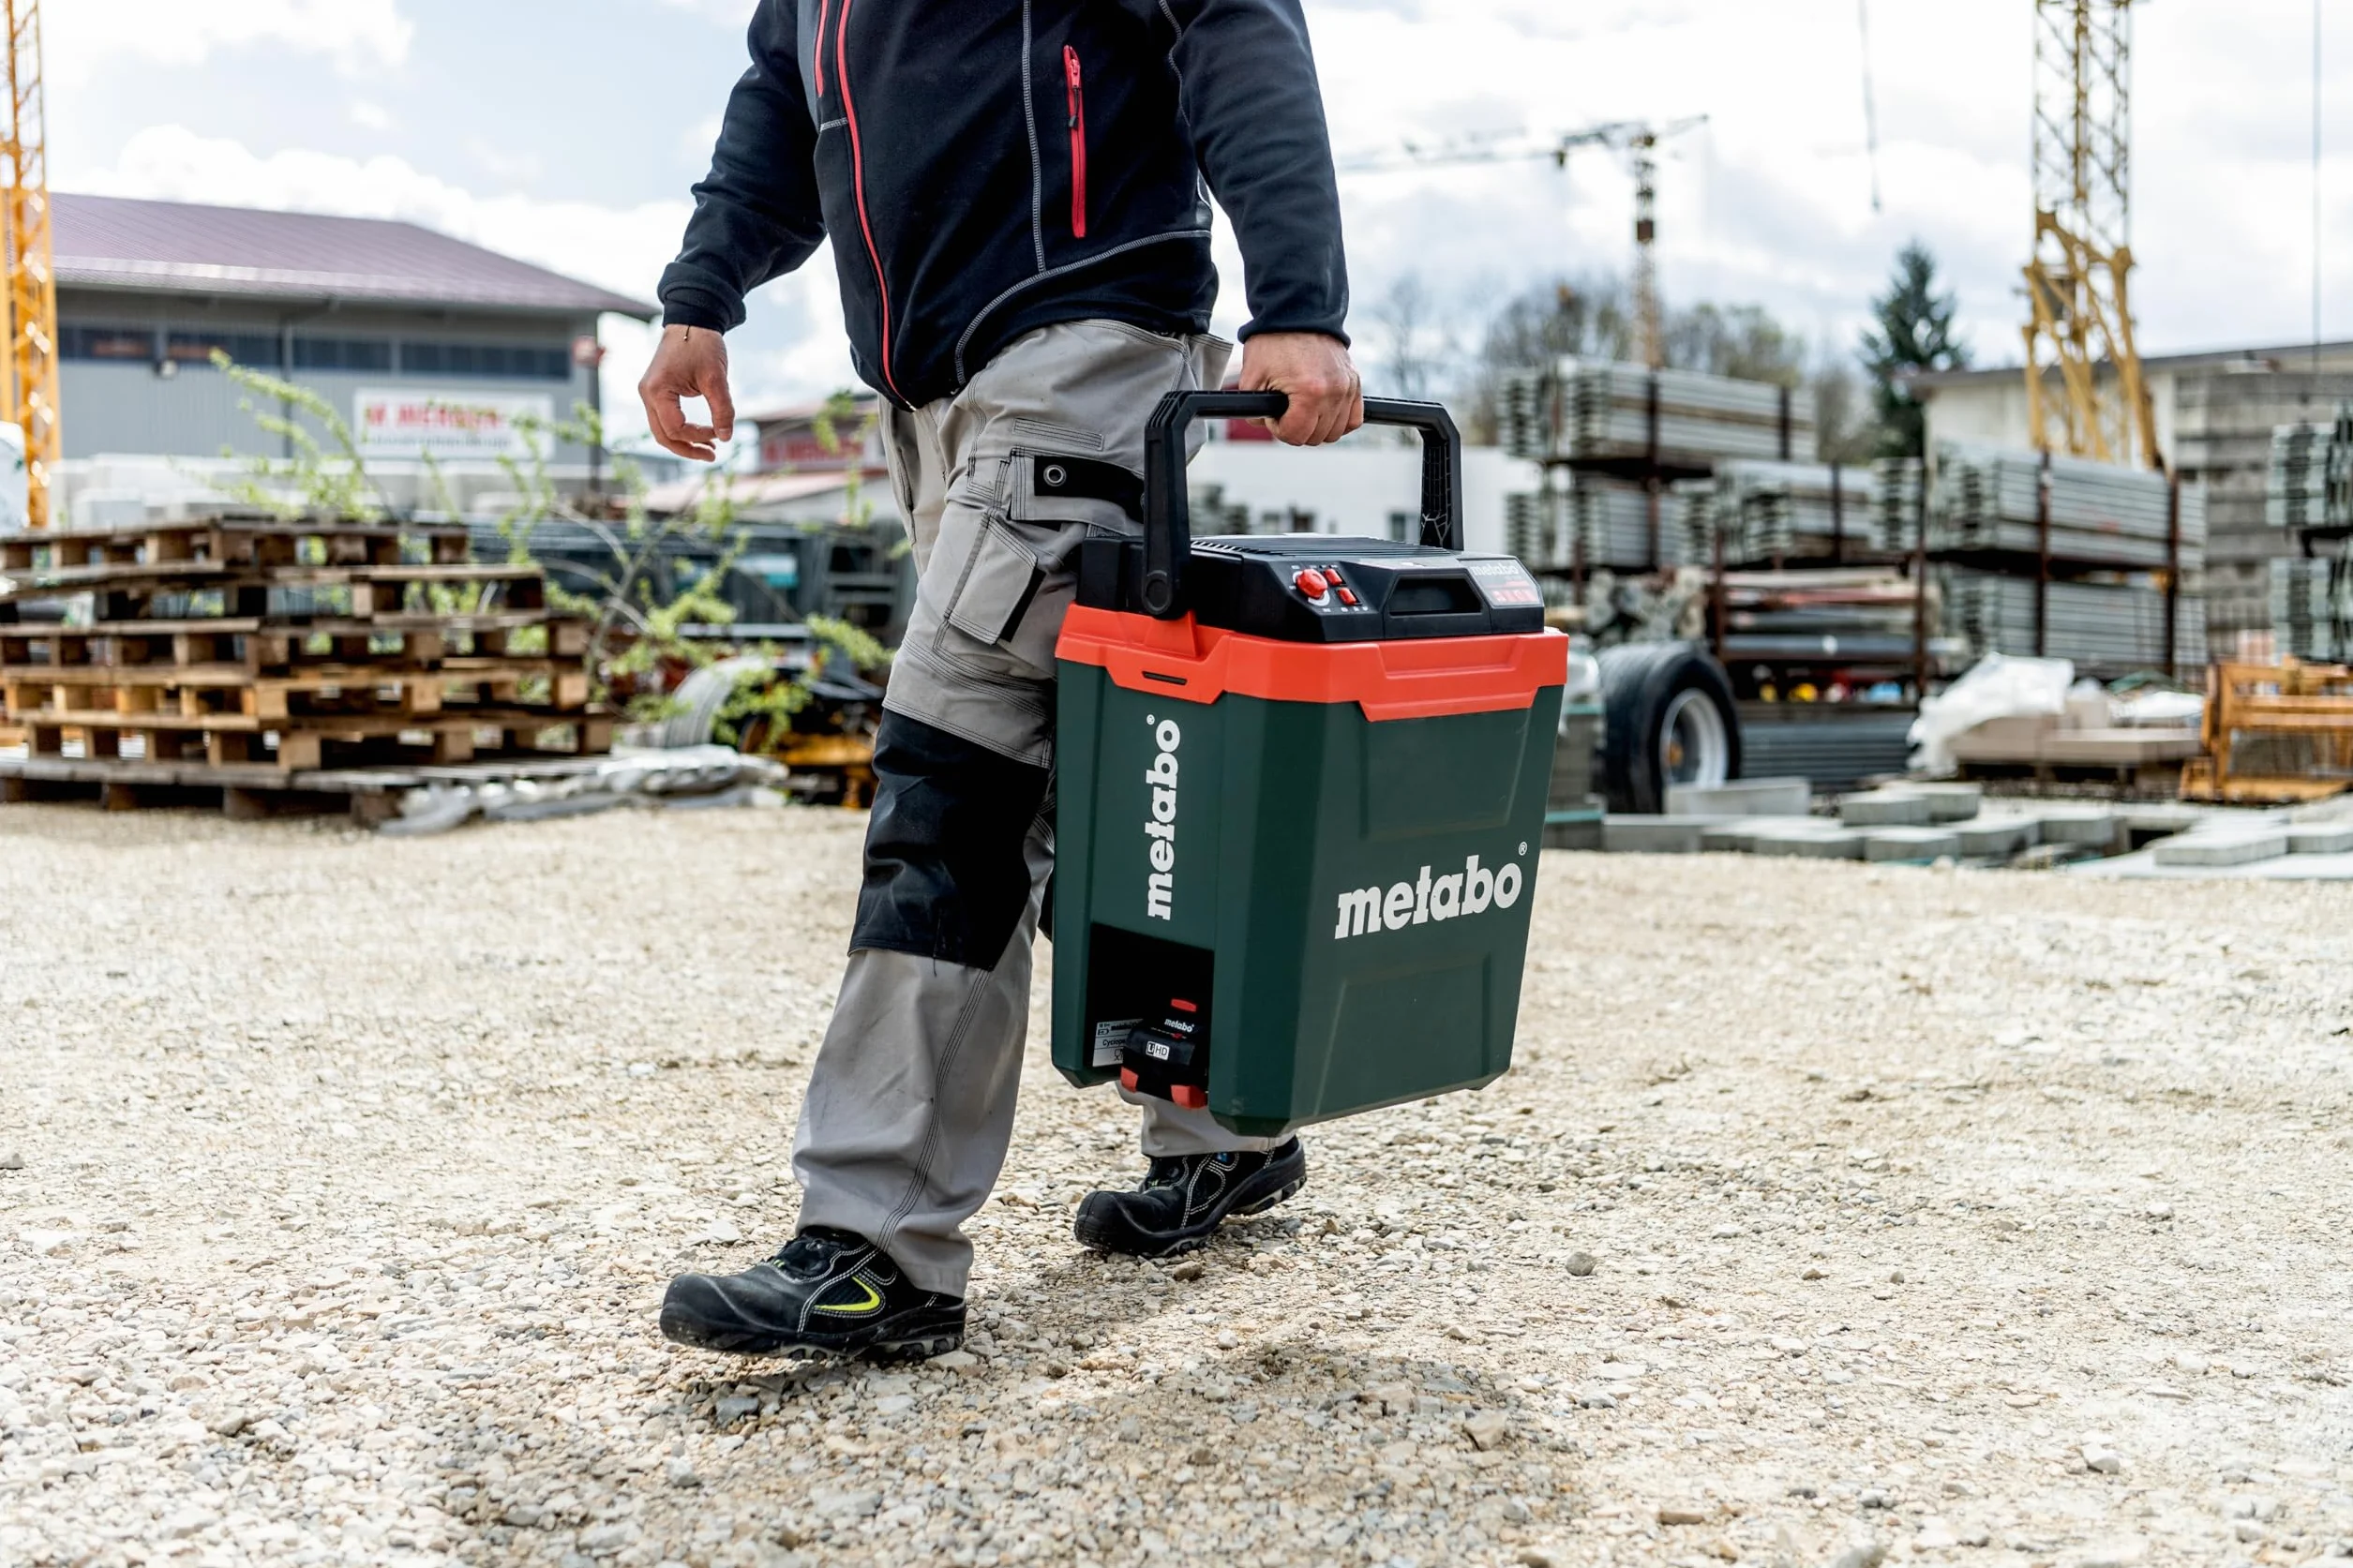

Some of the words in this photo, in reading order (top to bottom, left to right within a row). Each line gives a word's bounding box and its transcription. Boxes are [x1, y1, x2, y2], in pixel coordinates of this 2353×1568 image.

[1145, 719, 1181, 921] metabo
[1334, 854, 1522, 940] metabo
[1164, 1018, 1193, 1033] metabo
